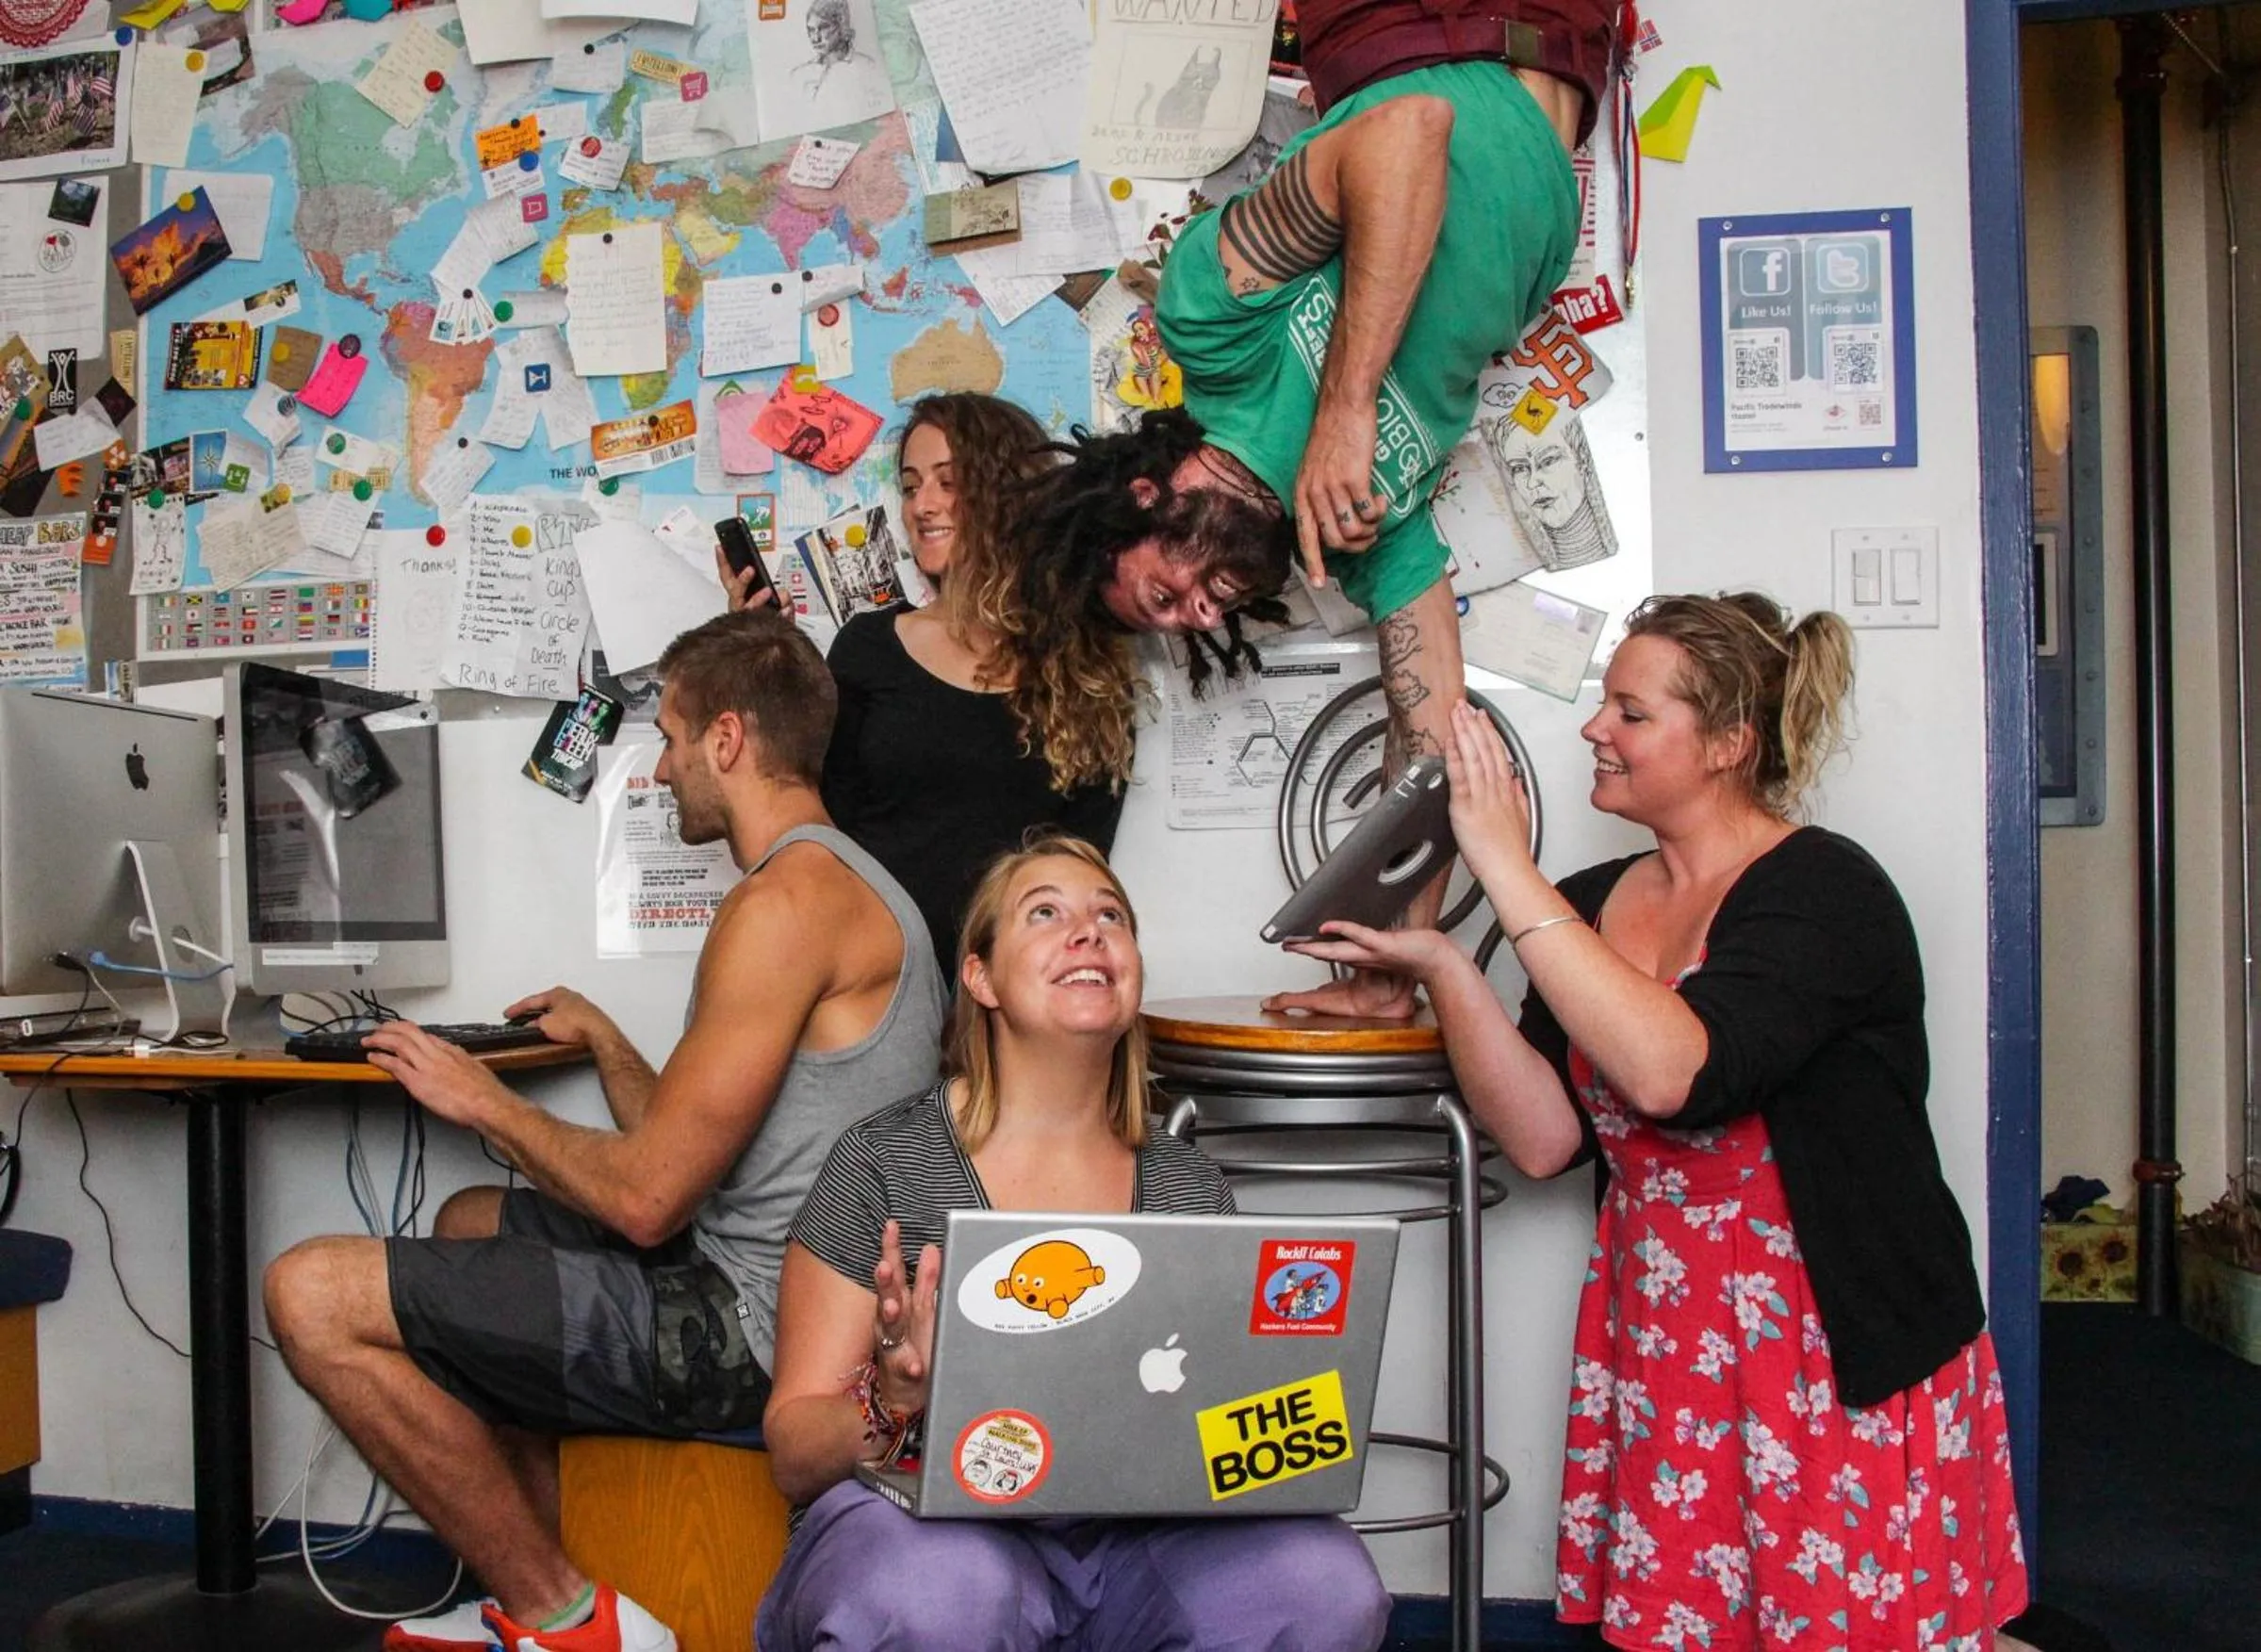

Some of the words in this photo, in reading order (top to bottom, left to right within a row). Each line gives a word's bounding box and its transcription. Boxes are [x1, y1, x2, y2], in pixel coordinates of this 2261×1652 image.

[1742, 306, 1767, 319] Like
[1770, 304, 1791, 317] Us!
[1810, 302, 1852, 315] Follow
[1856, 302, 1877, 314] Us!
[49, 390, 74, 403] BRC
[549, 466, 573, 480] THE
[400, 557, 459, 576] Thanks!
[458, 662, 498, 690] Ring
[504, 674, 518, 688] of
[527, 674, 561, 695] Fire
[629, 908, 716, 920] DIRECTL
[1302, 1323, 1336, 1333] Community
[1226, 1388, 1317, 1442] THE
[1210, 1420, 1347, 1493] BOSS
